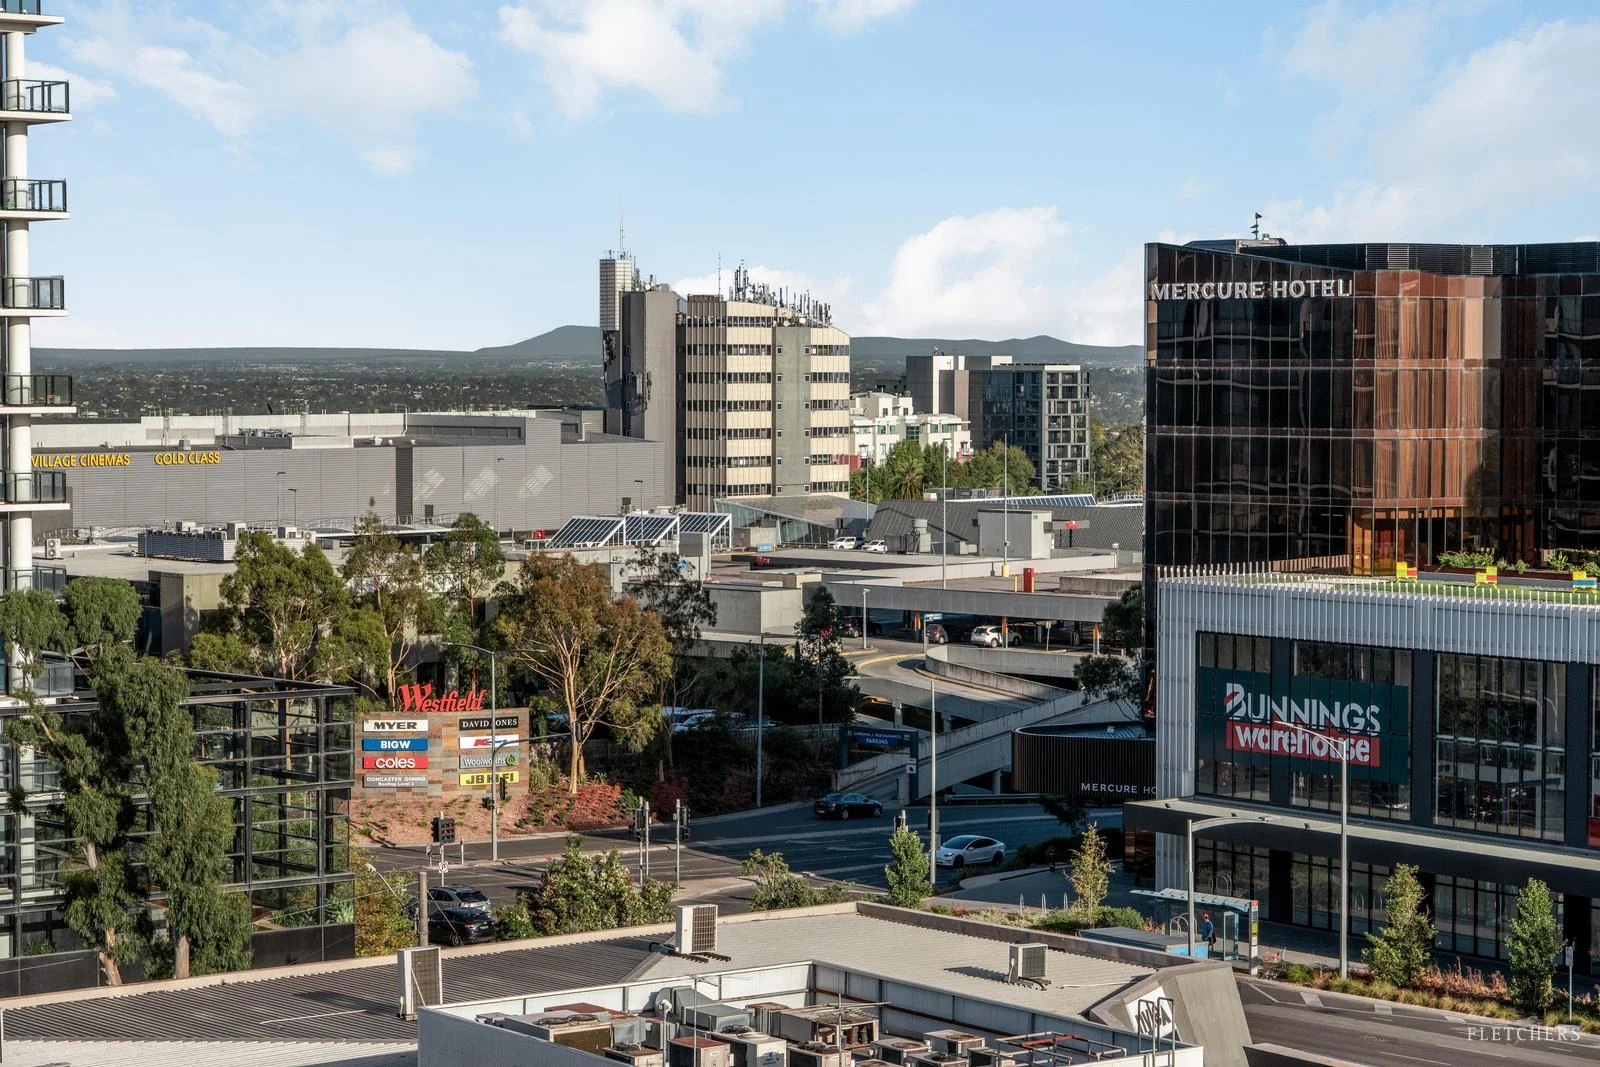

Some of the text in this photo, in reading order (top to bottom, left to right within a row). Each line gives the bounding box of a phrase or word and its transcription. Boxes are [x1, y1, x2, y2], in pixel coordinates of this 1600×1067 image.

[1151, 279, 1351, 300] MERCURE HOTEL
[31, 453, 130, 468] VILLAGE CINEMAS
[154, 451, 220, 465] GOLD CLASS
[398, 683, 486, 712] Westfield
[1224, 682, 1381, 737] BUNNINGS
[374, 721, 417, 730] MYER
[462, 718, 518, 728] DAVID ONES
[1235, 724, 1370, 762] warehouse
[375, 756, 416, 769] coles
[466, 774, 485, 784] JB
[1080, 783, 1138, 794] MERCURE
